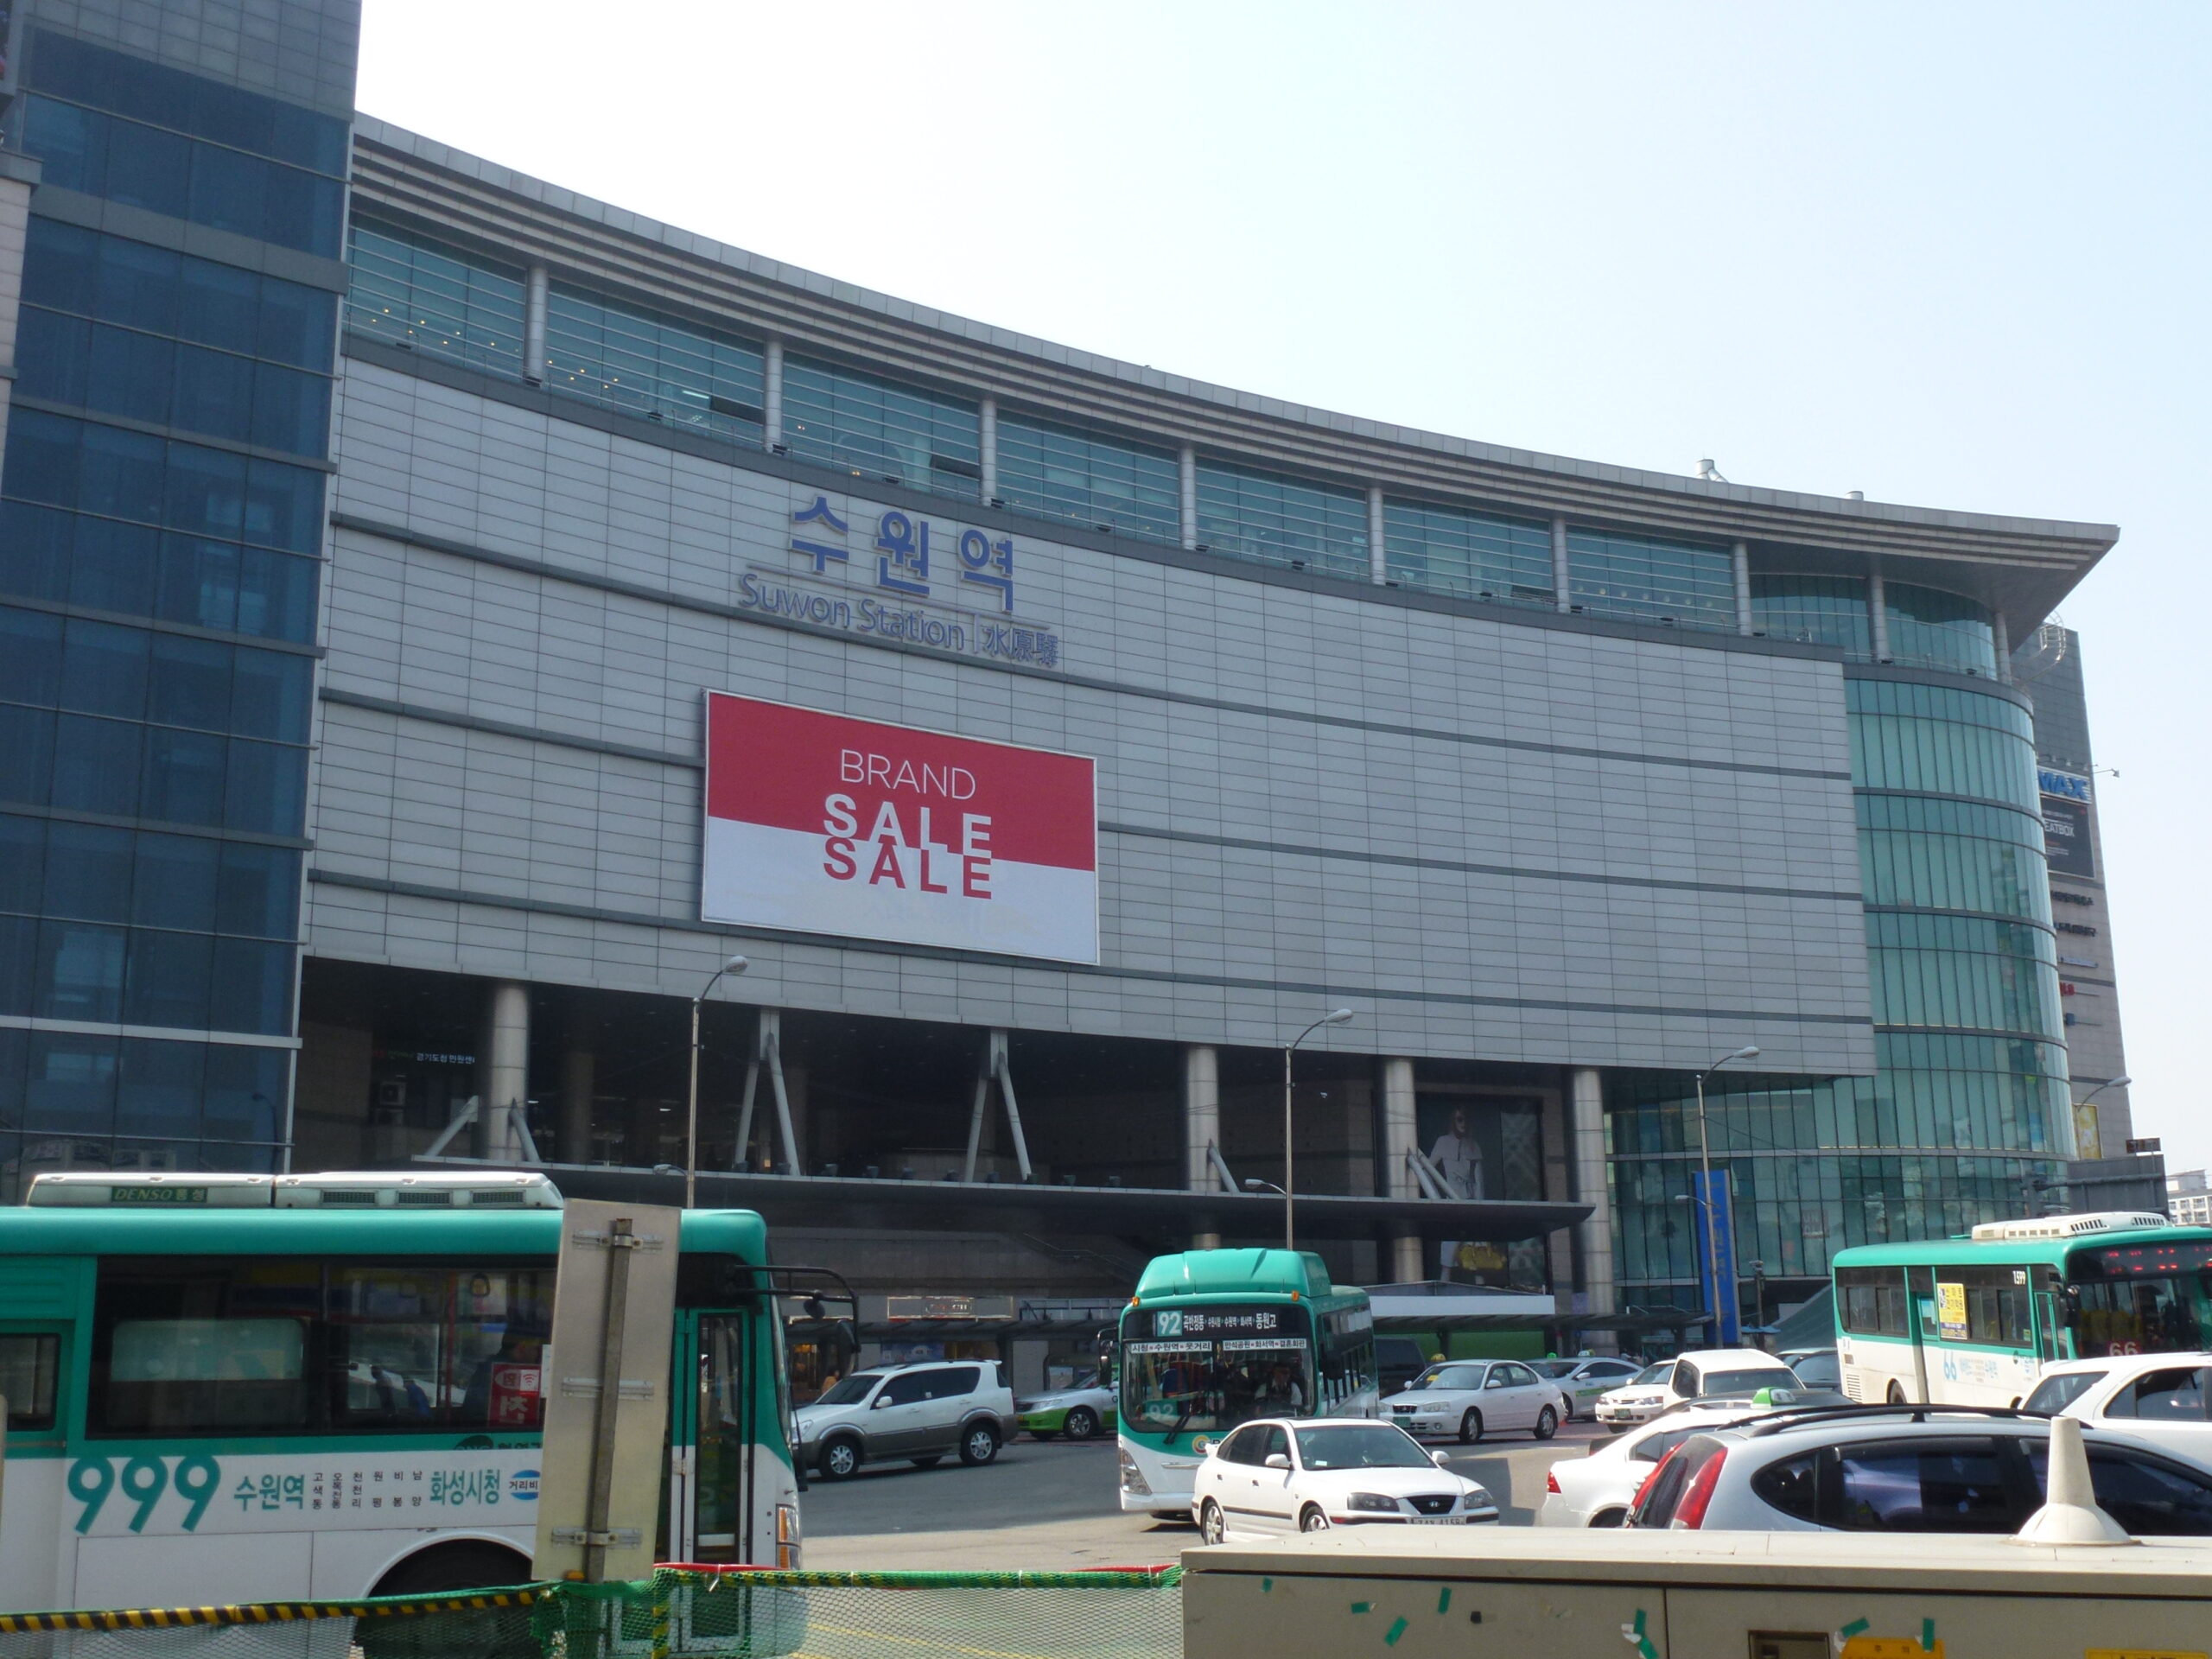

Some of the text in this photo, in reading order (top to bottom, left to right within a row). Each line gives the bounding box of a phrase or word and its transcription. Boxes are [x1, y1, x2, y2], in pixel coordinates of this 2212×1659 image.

[791, 496, 1014, 613] 수원역
[739, 573, 851, 628] Suwon
[858, 599, 965, 653] Station
[841, 748, 976, 801] BRAND
[823, 793, 993, 859] SALE
[823, 835, 993, 899] SALE
[449, 1054, 475, 1065] 민원센
[115, 1188, 173, 1201] DENSO
[1159, 1312, 1181, 1335] 92
[1255, 1313, 1276, 1330] 동원고
[1154, 1342, 1179, 1351] 수원역
[233, 1474, 304, 1511] 수원역
[430, 1469, 500, 1505] 화성시청
